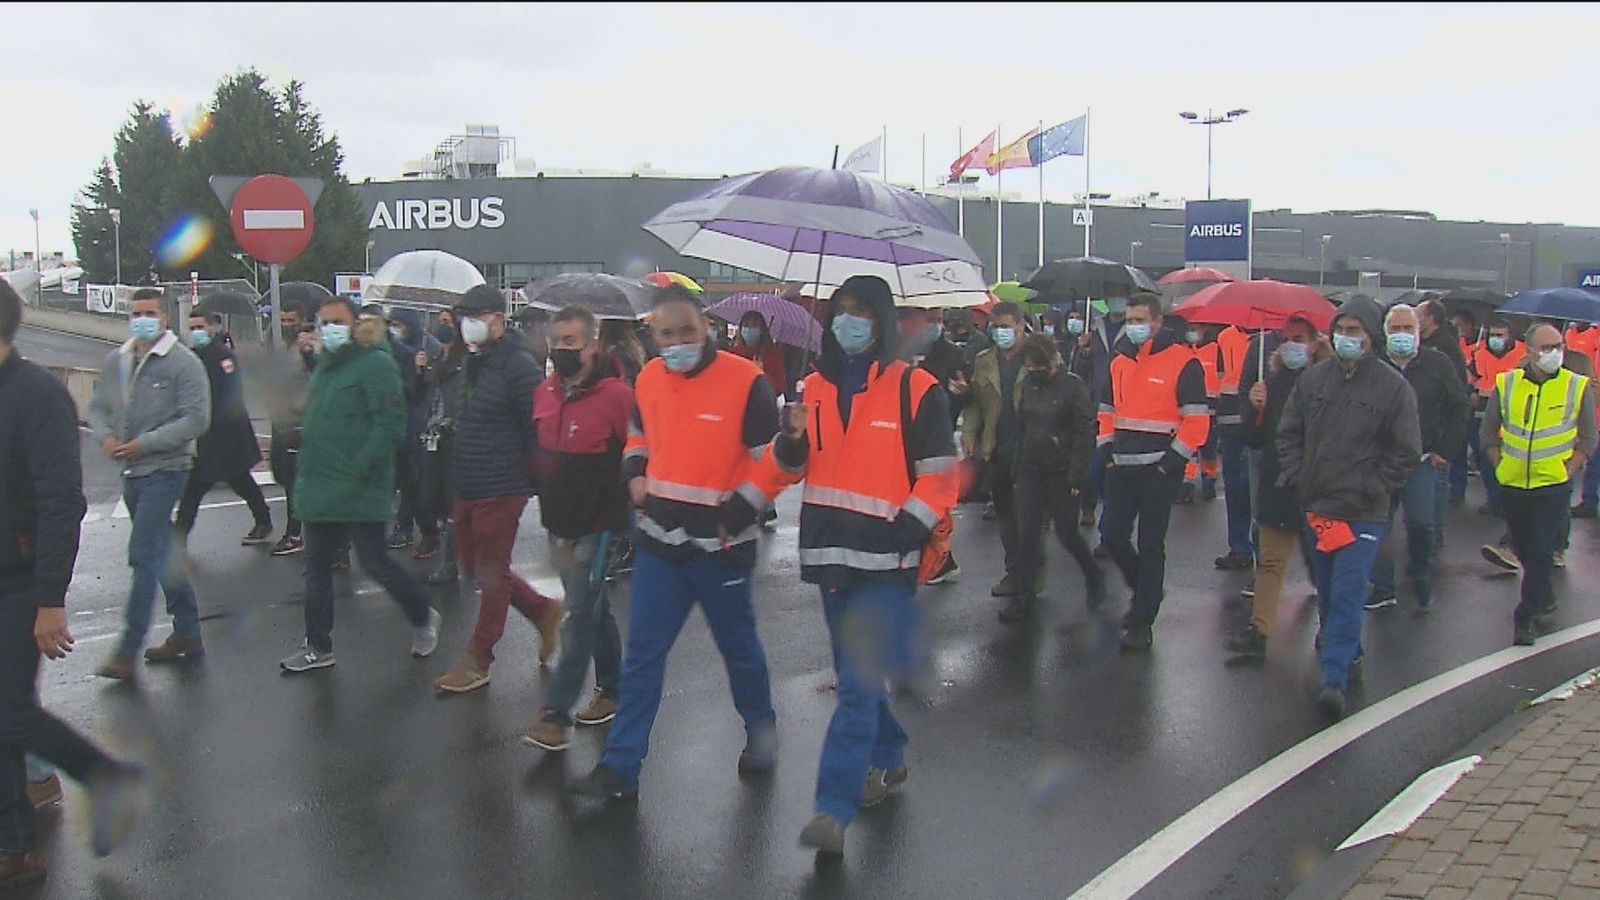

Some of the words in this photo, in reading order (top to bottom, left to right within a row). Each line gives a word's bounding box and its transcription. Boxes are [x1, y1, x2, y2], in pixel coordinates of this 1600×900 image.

[368, 196, 506, 230] AIRBUS
[1076, 211, 1085, 223] A
[1189, 223, 1242, 237] AIRBUS
